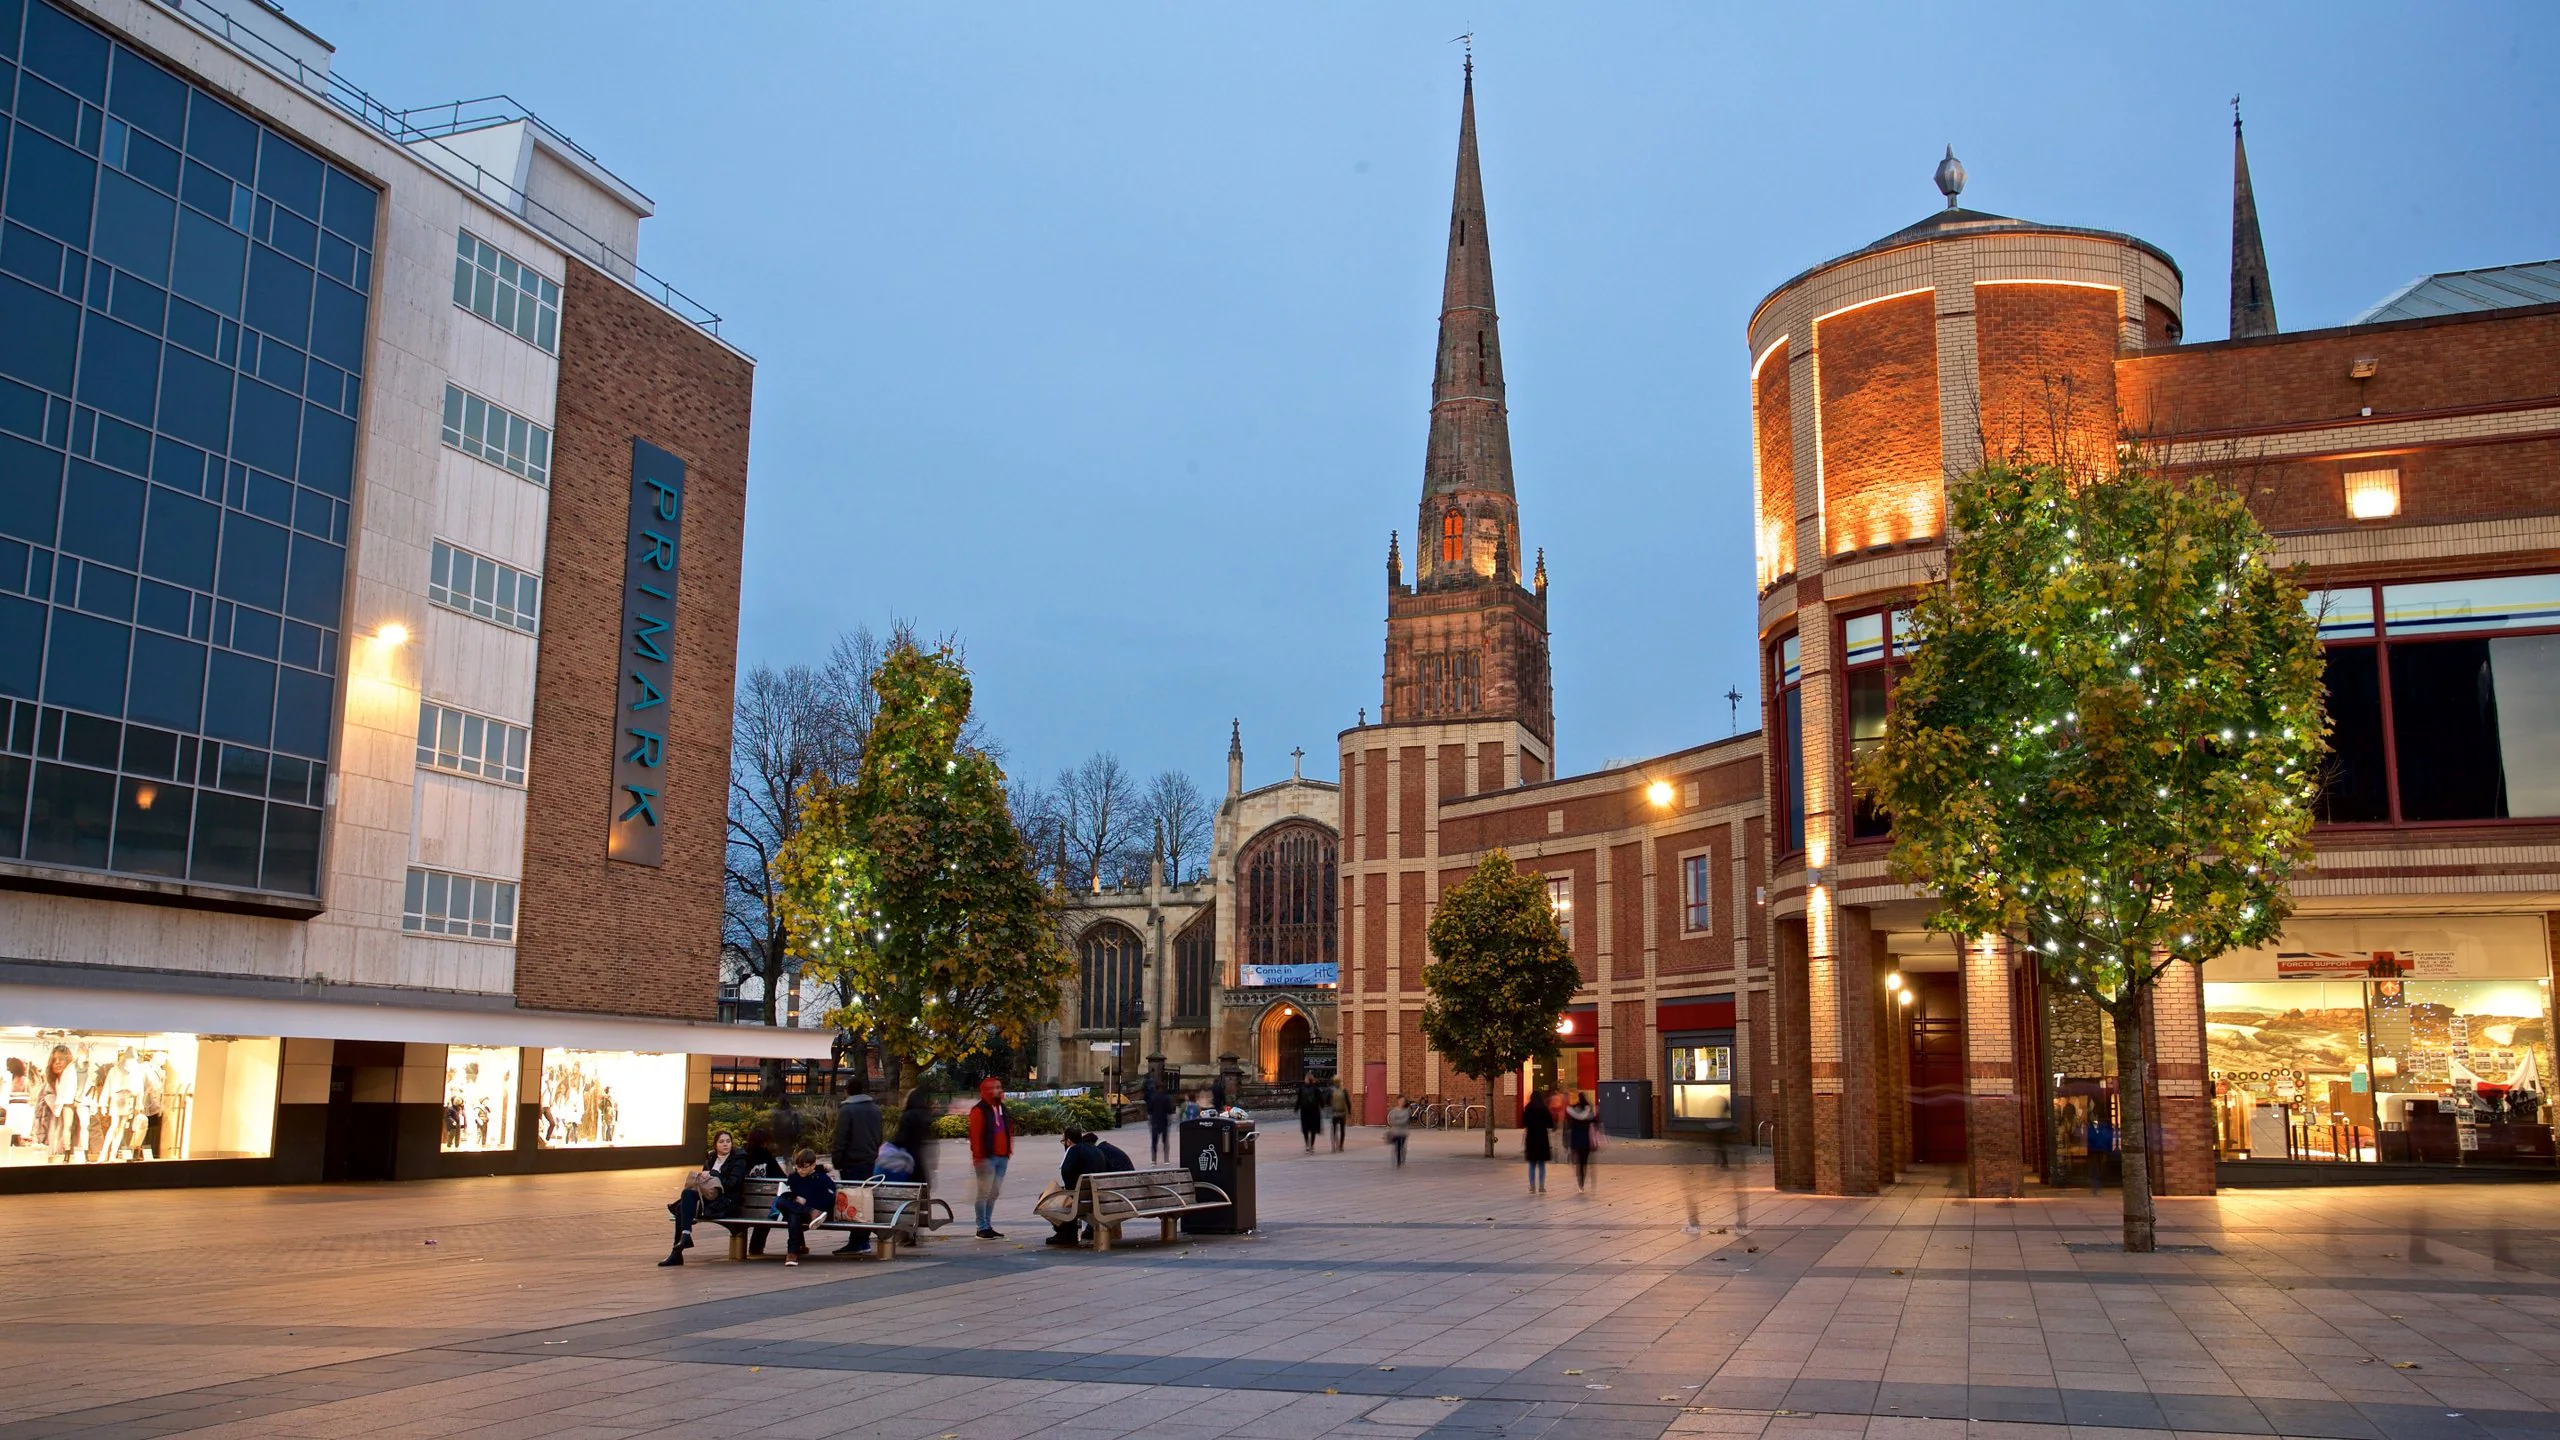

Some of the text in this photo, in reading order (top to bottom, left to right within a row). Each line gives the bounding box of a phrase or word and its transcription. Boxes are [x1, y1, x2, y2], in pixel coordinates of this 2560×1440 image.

[619, 477, 678, 828] PRIMARK
[1255, 966, 1282, 975] Come
[1284, 966, 1292, 974] in
